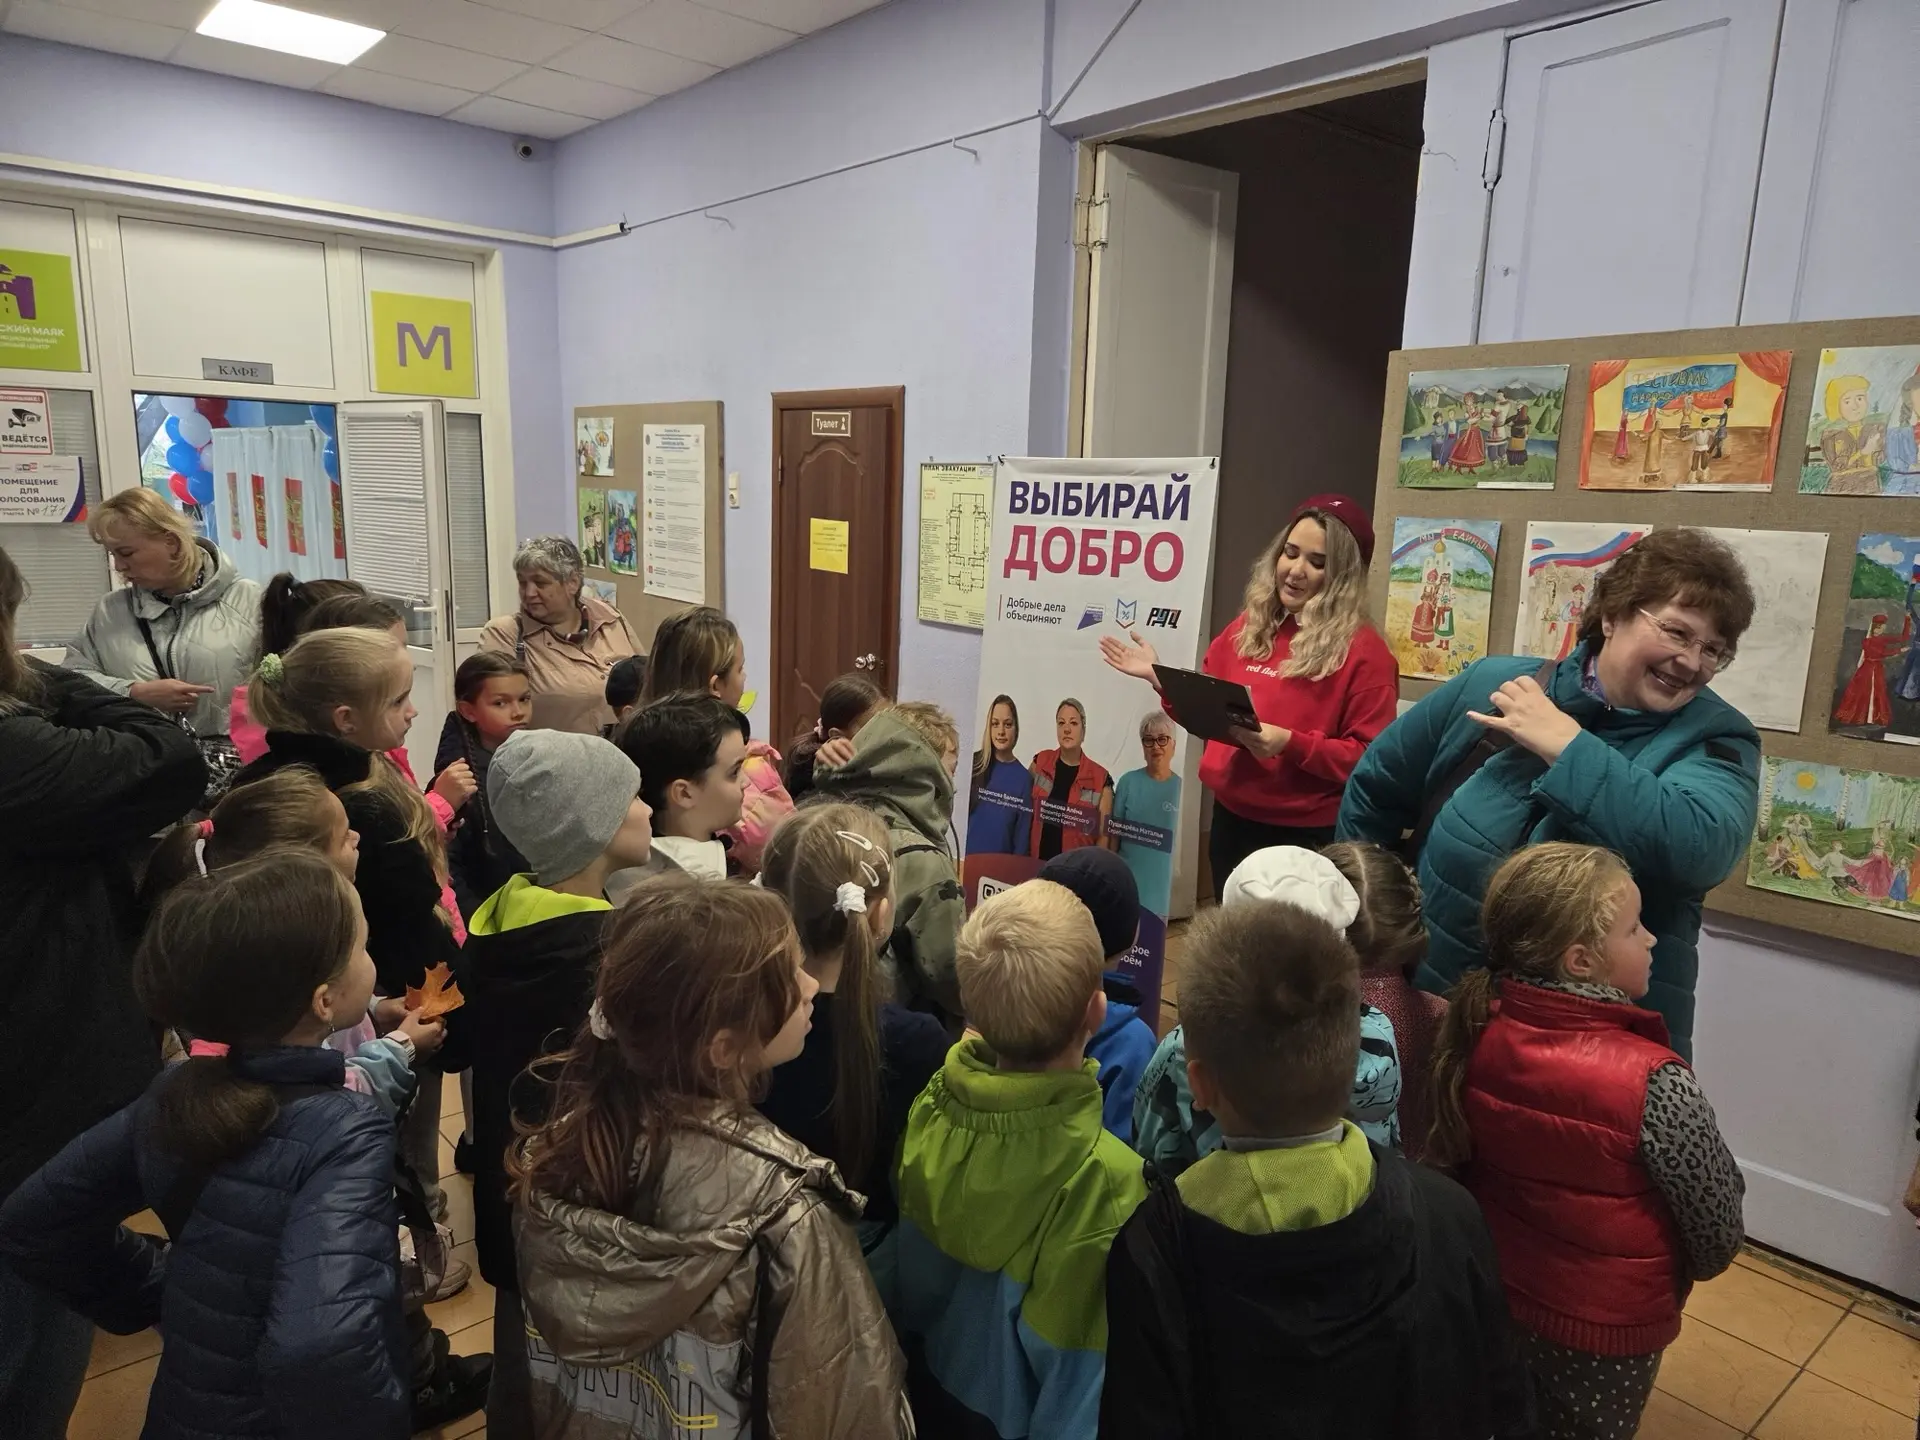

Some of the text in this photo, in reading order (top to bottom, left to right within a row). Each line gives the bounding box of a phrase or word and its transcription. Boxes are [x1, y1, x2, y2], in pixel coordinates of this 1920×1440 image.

[32, 327, 65, 337] МАЯК
[218, 365, 259, 378] КАФЕ
[816, 418, 839, 430] Туалет
[2, 433, 48, 443] ВЕДЁТСЯ
[941, 465, 976, 473] ЭВАКУАЦИИ
[20, 487, 39, 495] ДЛЯ
[1009, 473, 1191, 521] ВЫБИРАЙ
[27, 508, 39, 516] №
[1003, 525, 1184, 582] ДОБРО
[1007, 597, 1066, 613] Добрые дела
[1006, 611, 1062, 625] объединяют
[1246, 665, 1279, 678] red flag
[1041, 799, 1083, 816] Манькова Алёна
[1040, 807, 1090, 825] Волонтёр Российского
[1040, 813, 1076, 827] Красного Креста
[1108, 819, 1164, 838] Пушкарёва Наталья
[1107, 826, 1162, 846] Серебряный волонтёр
[1120, 954, 1142, 967] оём
